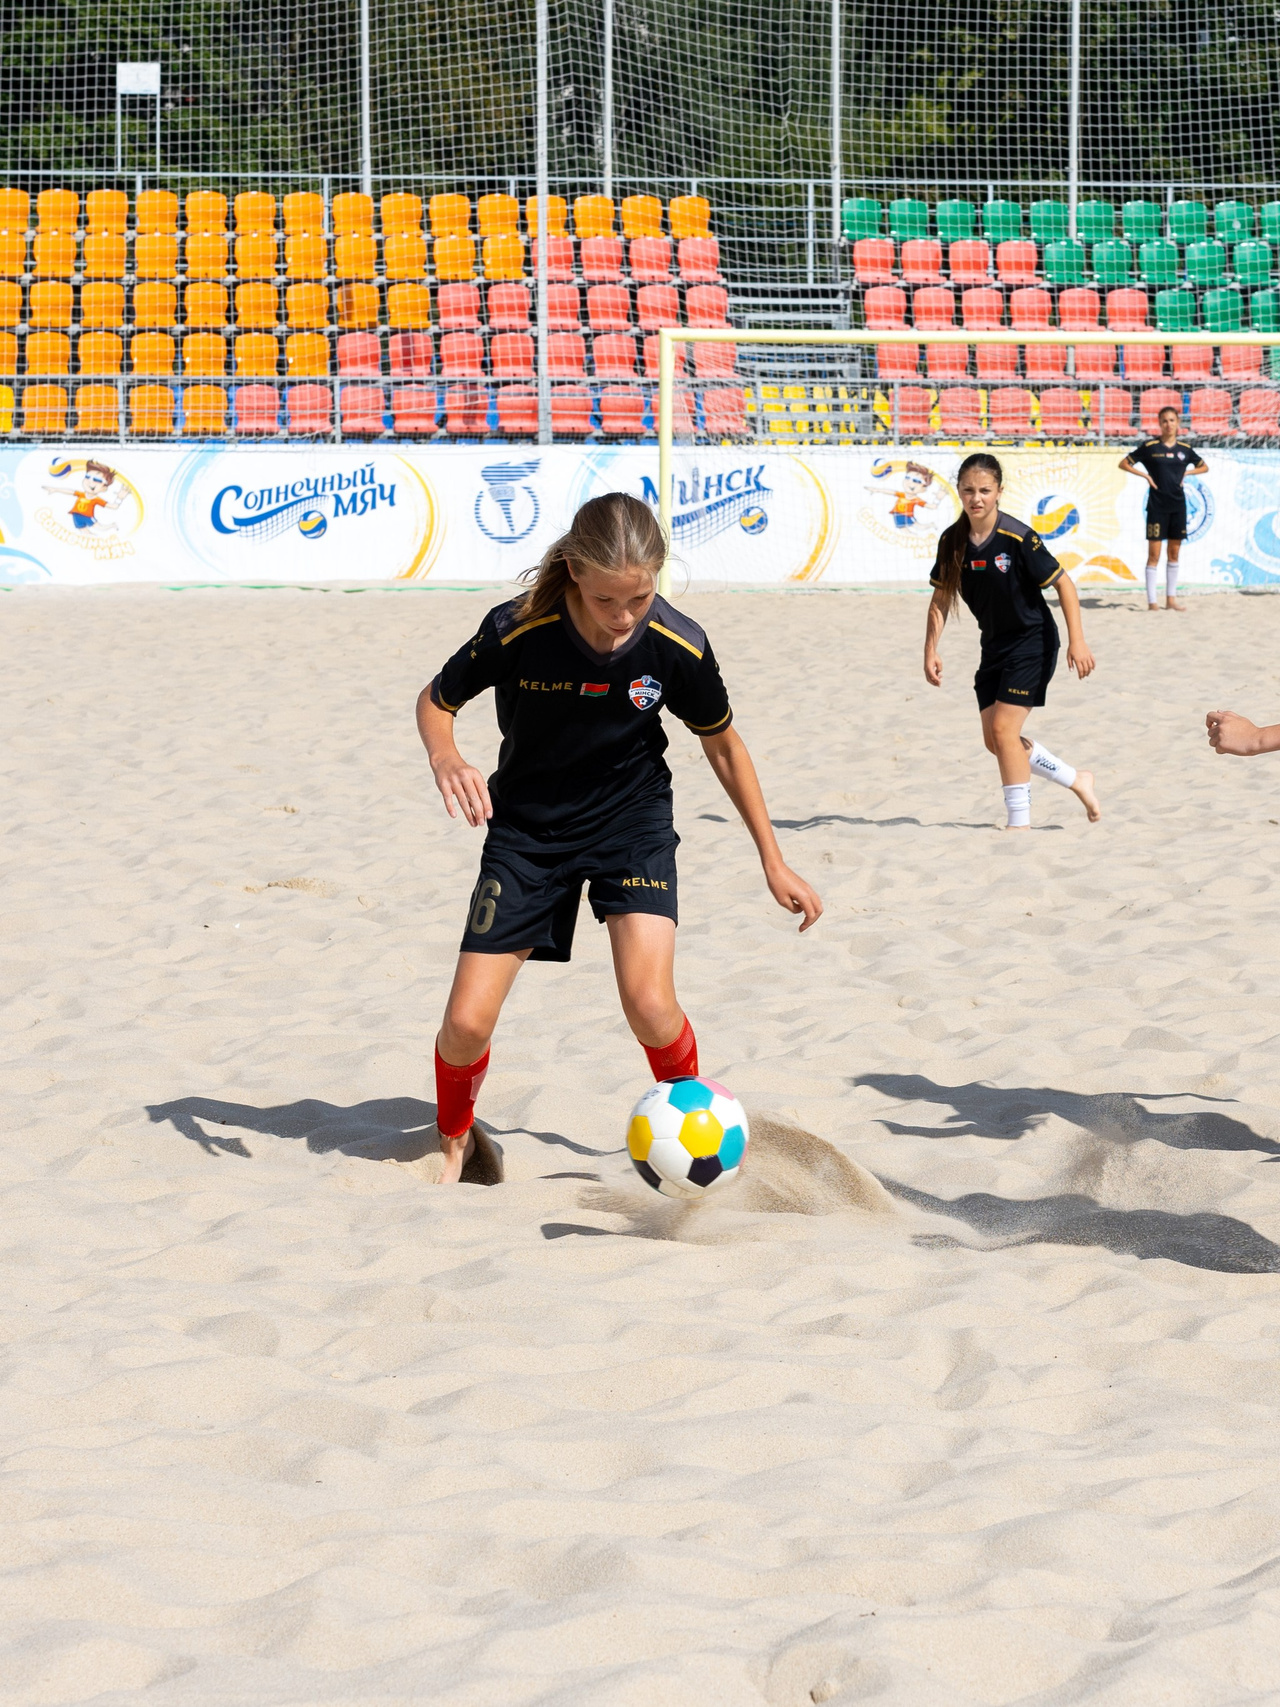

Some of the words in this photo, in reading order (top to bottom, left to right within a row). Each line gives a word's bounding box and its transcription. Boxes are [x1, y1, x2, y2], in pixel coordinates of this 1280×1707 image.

[211, 461, 376, 535] Солнечный
[519, 679, 573, 691] KELME
[1008, 688, 1030, 696] KELME
[622, 877, 668, 891] KELME
[465, 879, 501, 934] 6
